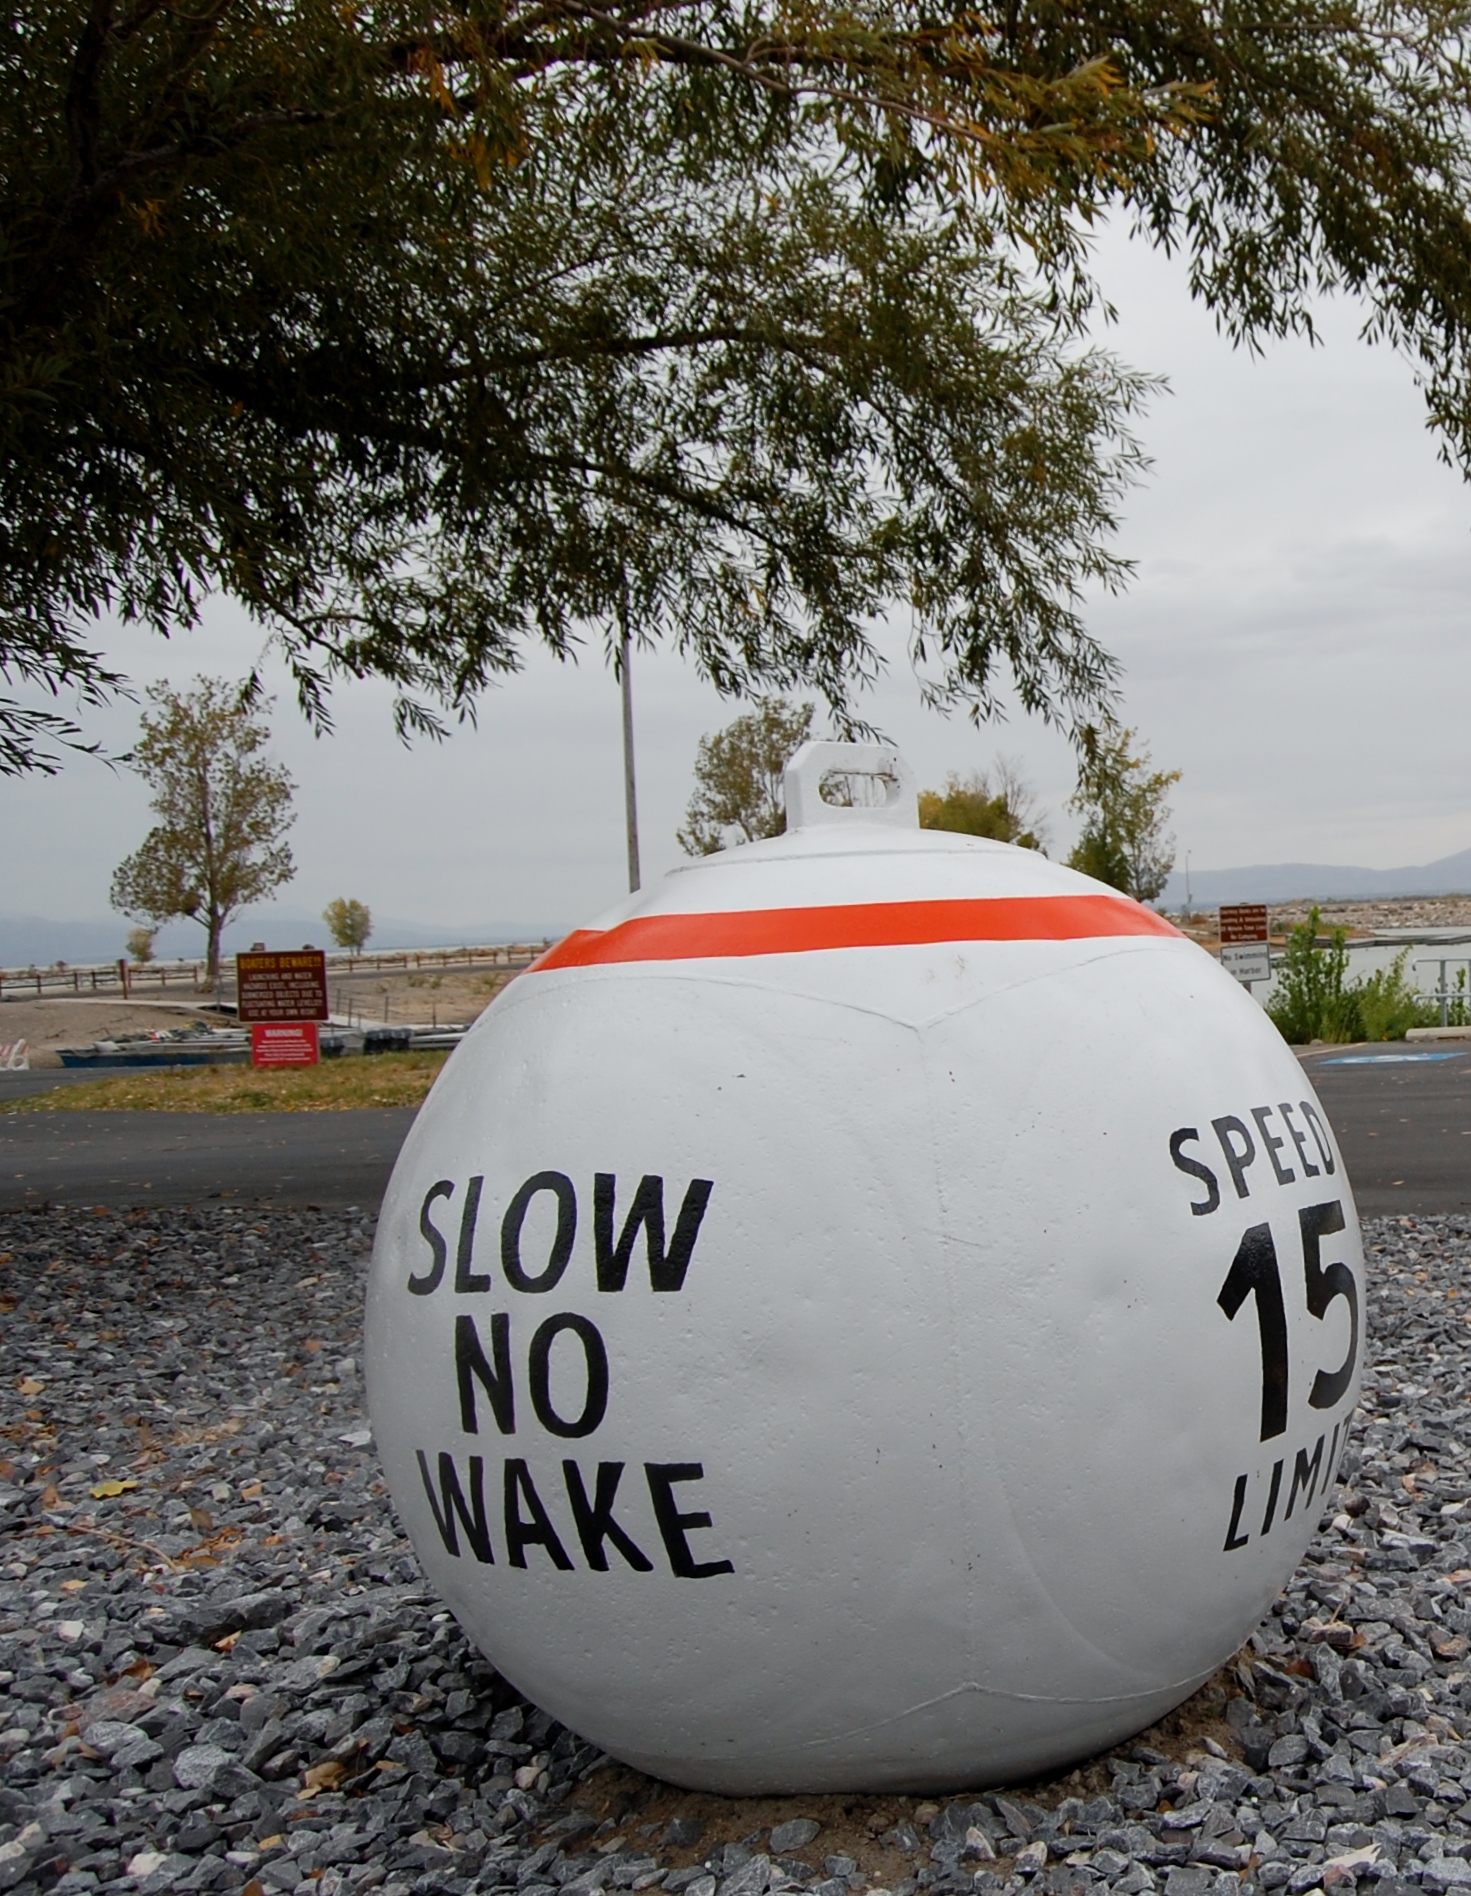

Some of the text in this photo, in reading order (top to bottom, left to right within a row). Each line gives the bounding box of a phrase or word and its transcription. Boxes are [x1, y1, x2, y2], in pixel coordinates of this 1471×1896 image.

[240, 957, 276, 970] BOATERS
[281, 972, 292, 980] AND
[294, 971, 313, 980] WATER
[1169, 1100, 1335, 1217] SPEED
[407, 1170, 715, 1296] SLOW
[454, 1311, 609, 1439] NO
[1216, 1199, 1359, 1443] 15
[415, 1449, 736, 1579] WAKE
